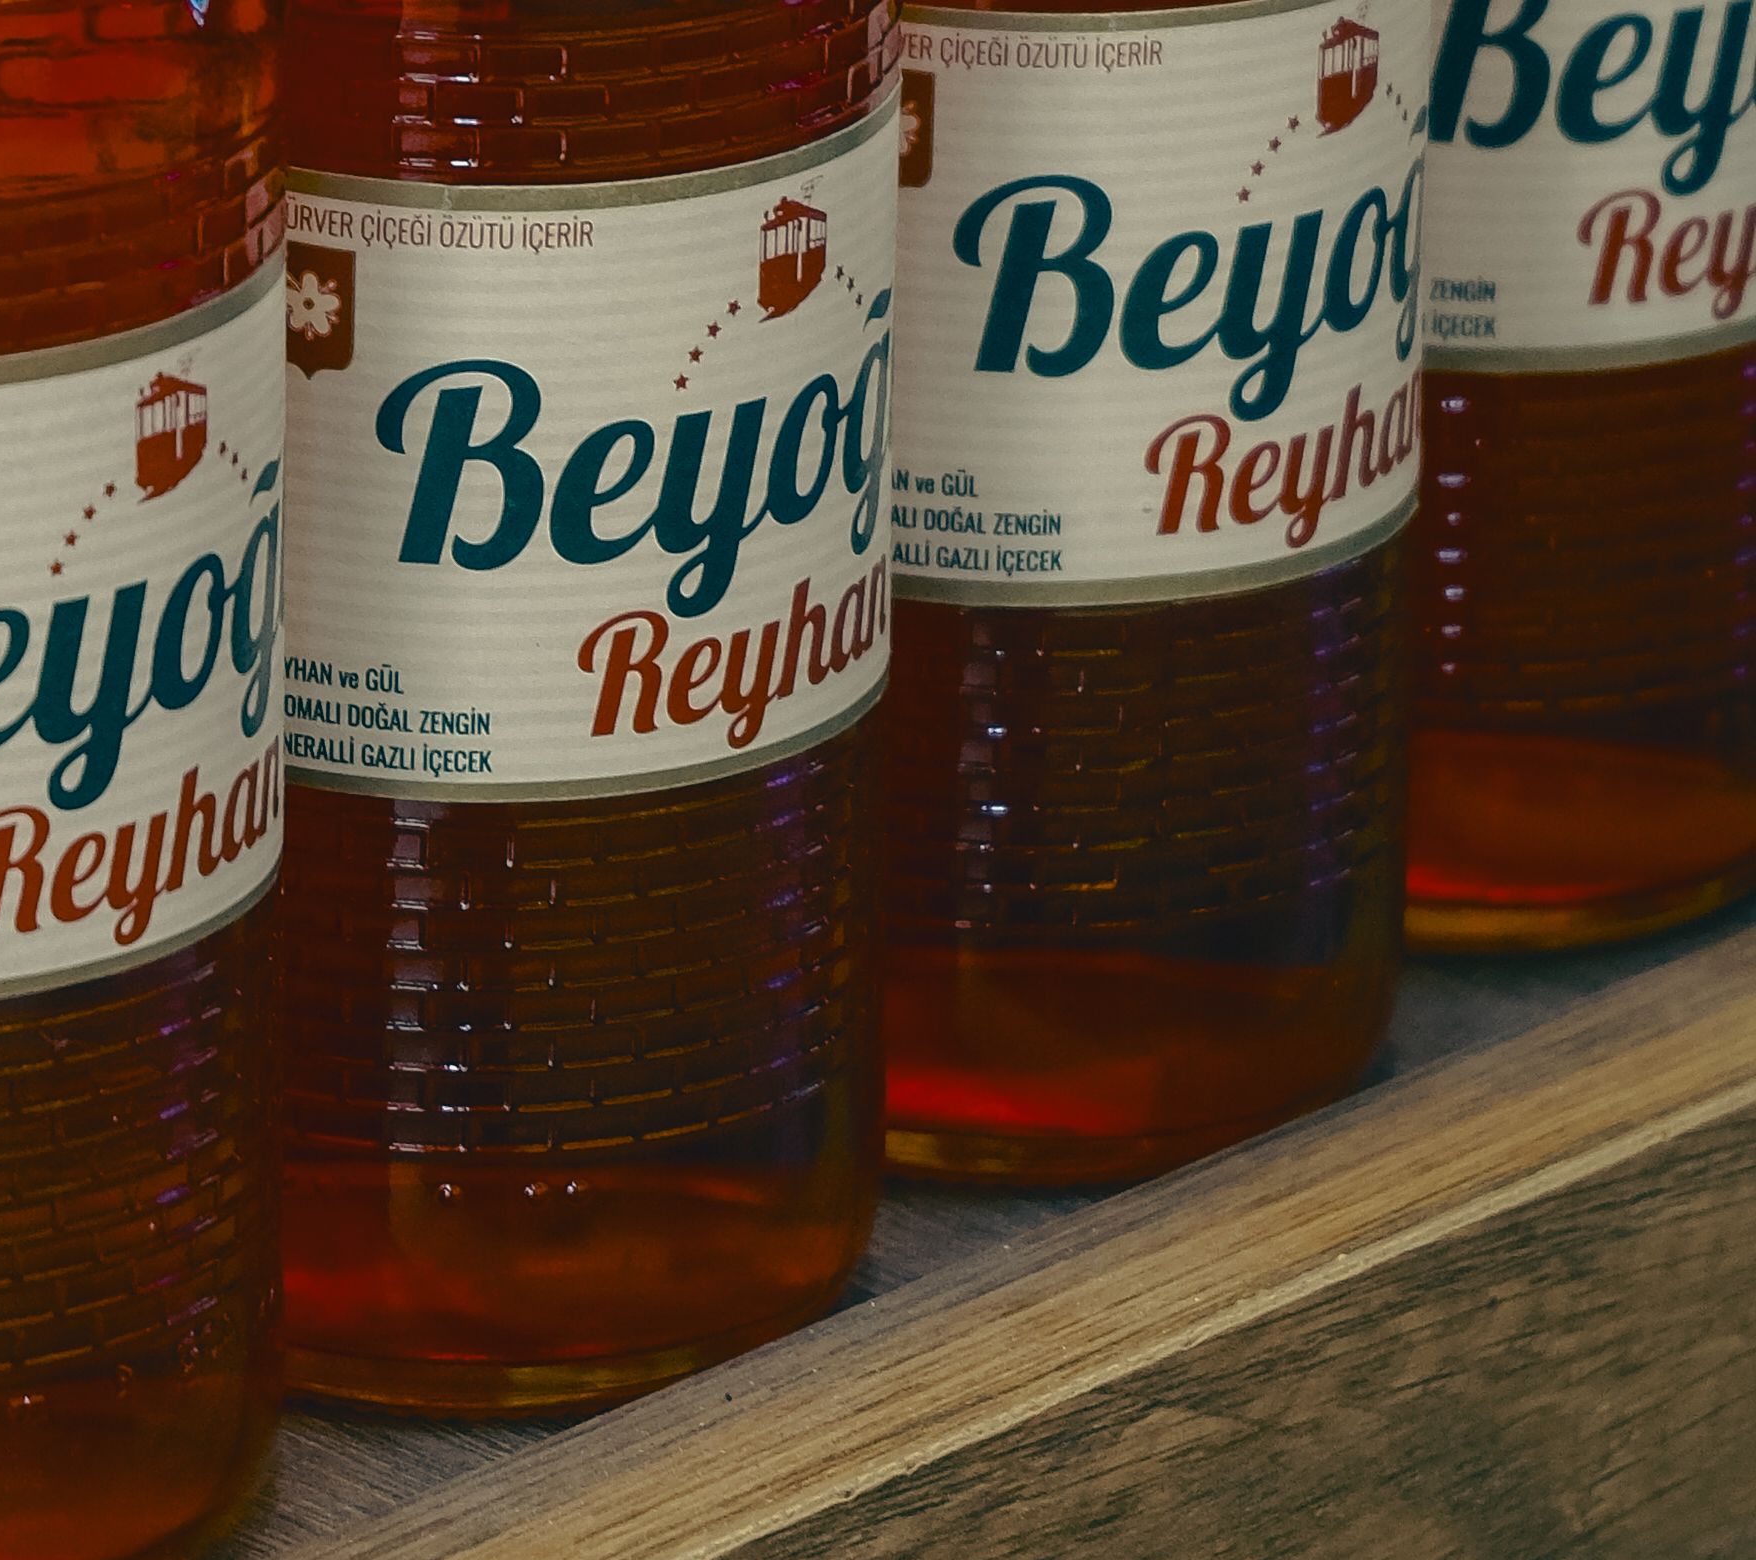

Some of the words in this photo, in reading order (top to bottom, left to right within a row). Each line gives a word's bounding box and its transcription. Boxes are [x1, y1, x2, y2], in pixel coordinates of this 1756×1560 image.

[940, 33, 1009, 70] ÇİÇEĞİ
[1016, 35, 1088, 69] ÖZÜTÜ
[1095, 35, 1163, 73] İÇERİR
[361, 209, 432, 247] ÇİÇEĞİ
[440, 214, 514, 250] ÖZÜTÜ
[522, 216, 594, 254] İÇERİR
[915, 476, 935, 494] ve
[941, 469, 979, 498] GÜL
[923, 506, 987, 535] DOĞAL
[993, 509, 1061, 536] ZENGİN
[936, 546, 989, 572] GAZLI
[996, 545, 1062, 577] İÇECEK
[339, 671, 359, 690] ve
[365, 664, 404, 694] GÜL
[284, 695, 340, 725] OMALI
[348, 702, 413, 733] DOĞAL
[419, 707, 490, 735] ZENGİN
[361, 744, 415, 770] GAZLI
[423, 744, 492, 777] İÇECEK
